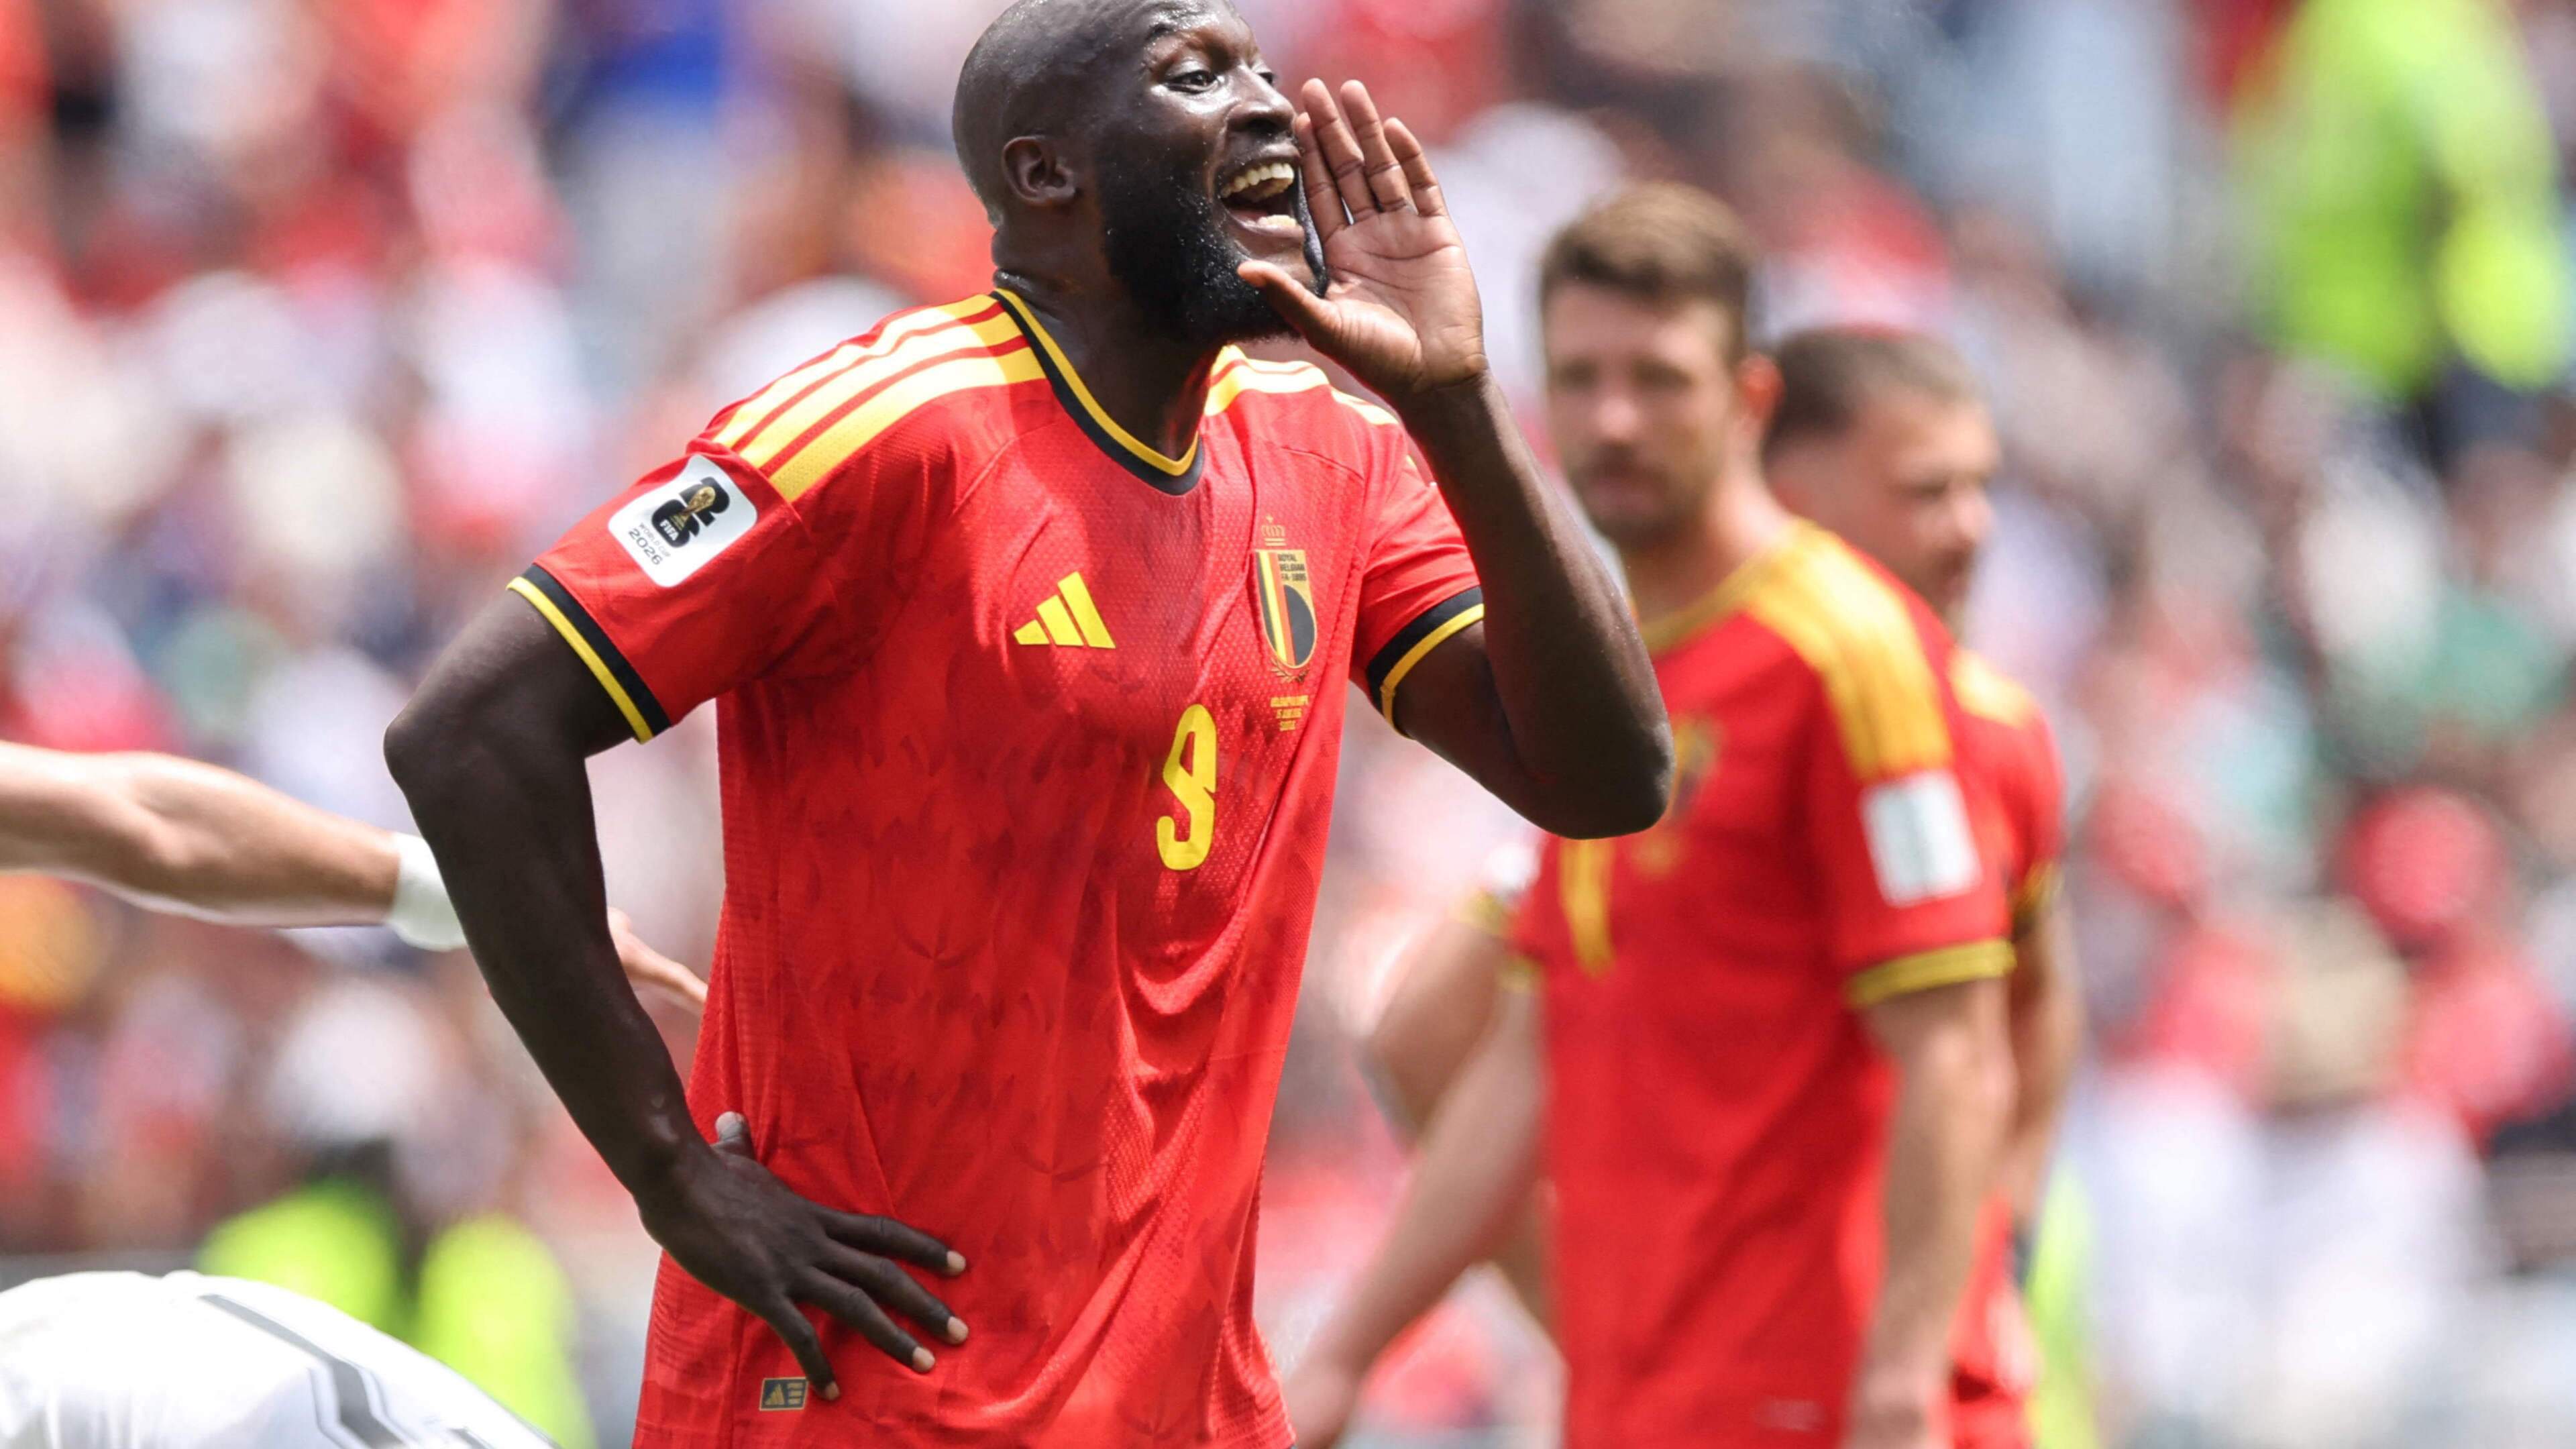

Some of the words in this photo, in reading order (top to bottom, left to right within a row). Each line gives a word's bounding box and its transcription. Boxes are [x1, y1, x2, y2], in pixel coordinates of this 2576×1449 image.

[628, 528, 663, 565] 2026
[639, 522, 659, 545] WORLD
[658, 545, 672, 557] CUP
[659, 519, 679, 541] FIFA
[1157, 704, 1217, 870] 9
